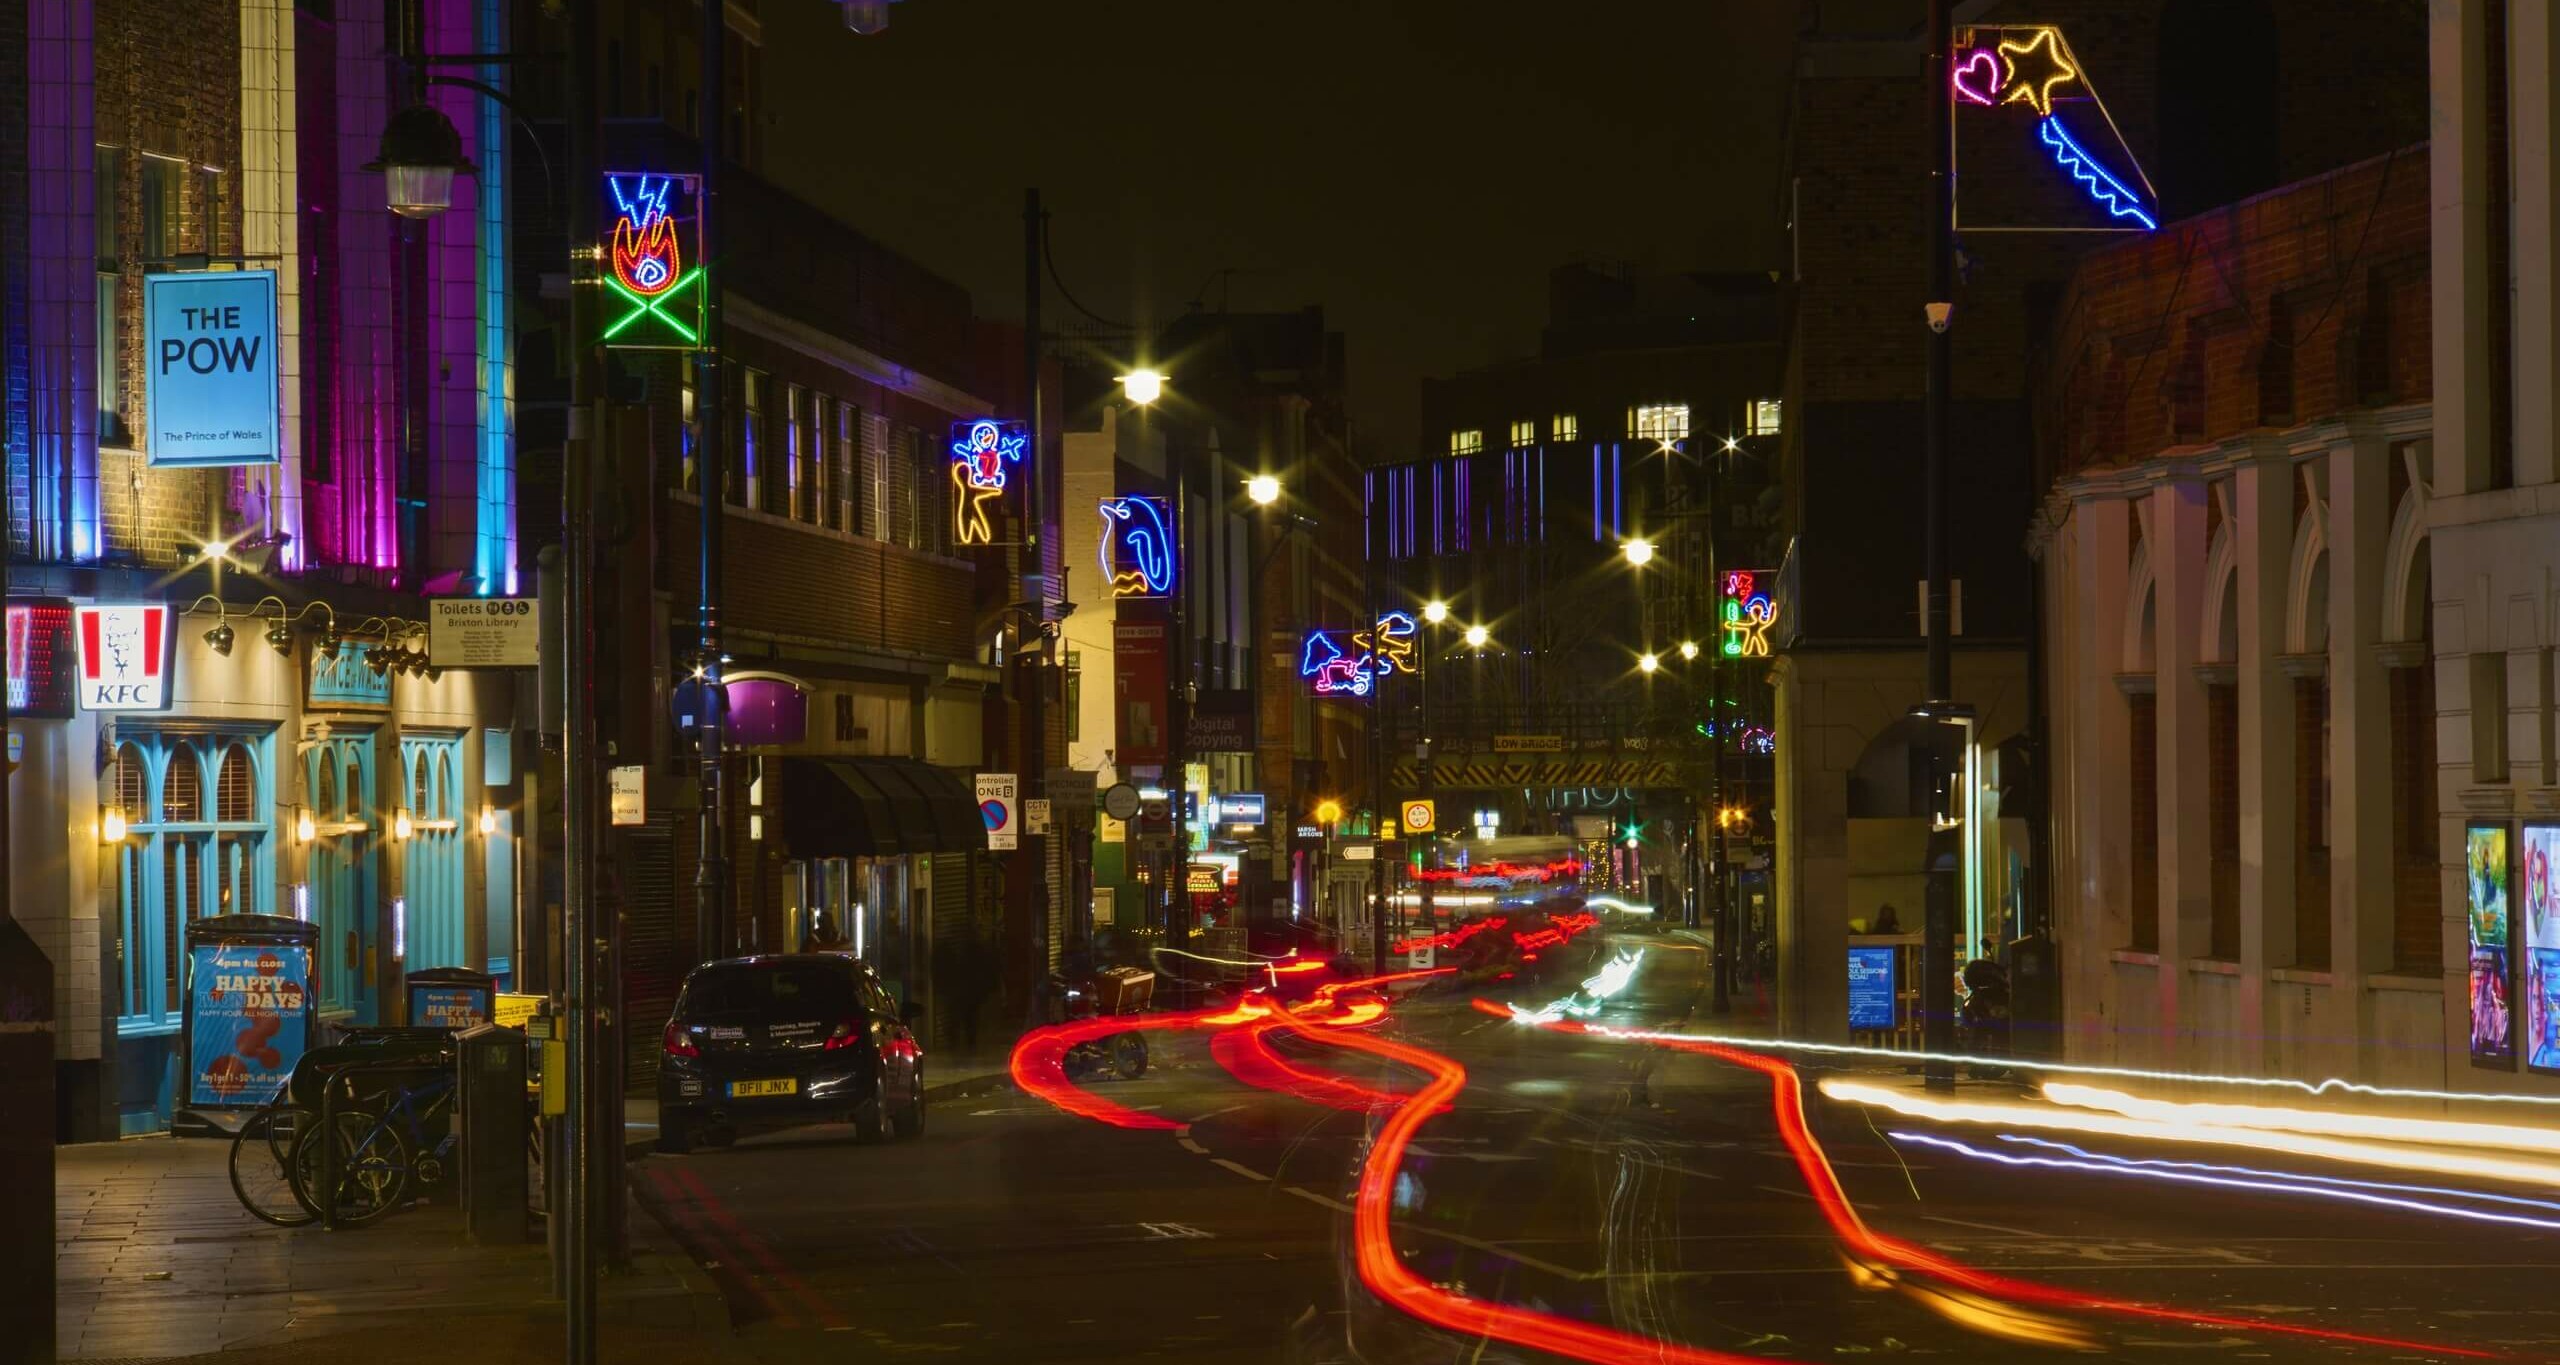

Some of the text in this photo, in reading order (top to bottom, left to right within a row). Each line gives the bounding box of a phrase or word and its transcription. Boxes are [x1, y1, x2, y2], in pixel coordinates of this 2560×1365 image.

[181, 306, 241, 331] THE
[161, 336, 262, 376] POW
[164, 429, 263, 442] The Prince of Wales
[437, 603, 482, 615] Toilets
[448, 618, 519, 628] Brixton Library
[96, 684, 149, 704] KFC
[1187, 717, 1235, 733] Digital
[1494, 739, 1518, 749] LOW
[1519, 739, 1562, 749] BRIDGE
[976, 776, 1014, 785] ontrolled
[977, 787, 1002, 796] ONE
[1026, 801, 1048, 809] CCTV
[215, 975, 286, 991] HAPPY
[199, 1010, 220, 1018] HAPPY
[244, 1010, 256, 1018] ALL
[427, 1005, 473, 1016] HAPPY
[765, 1080, 790, 1093] JNX
